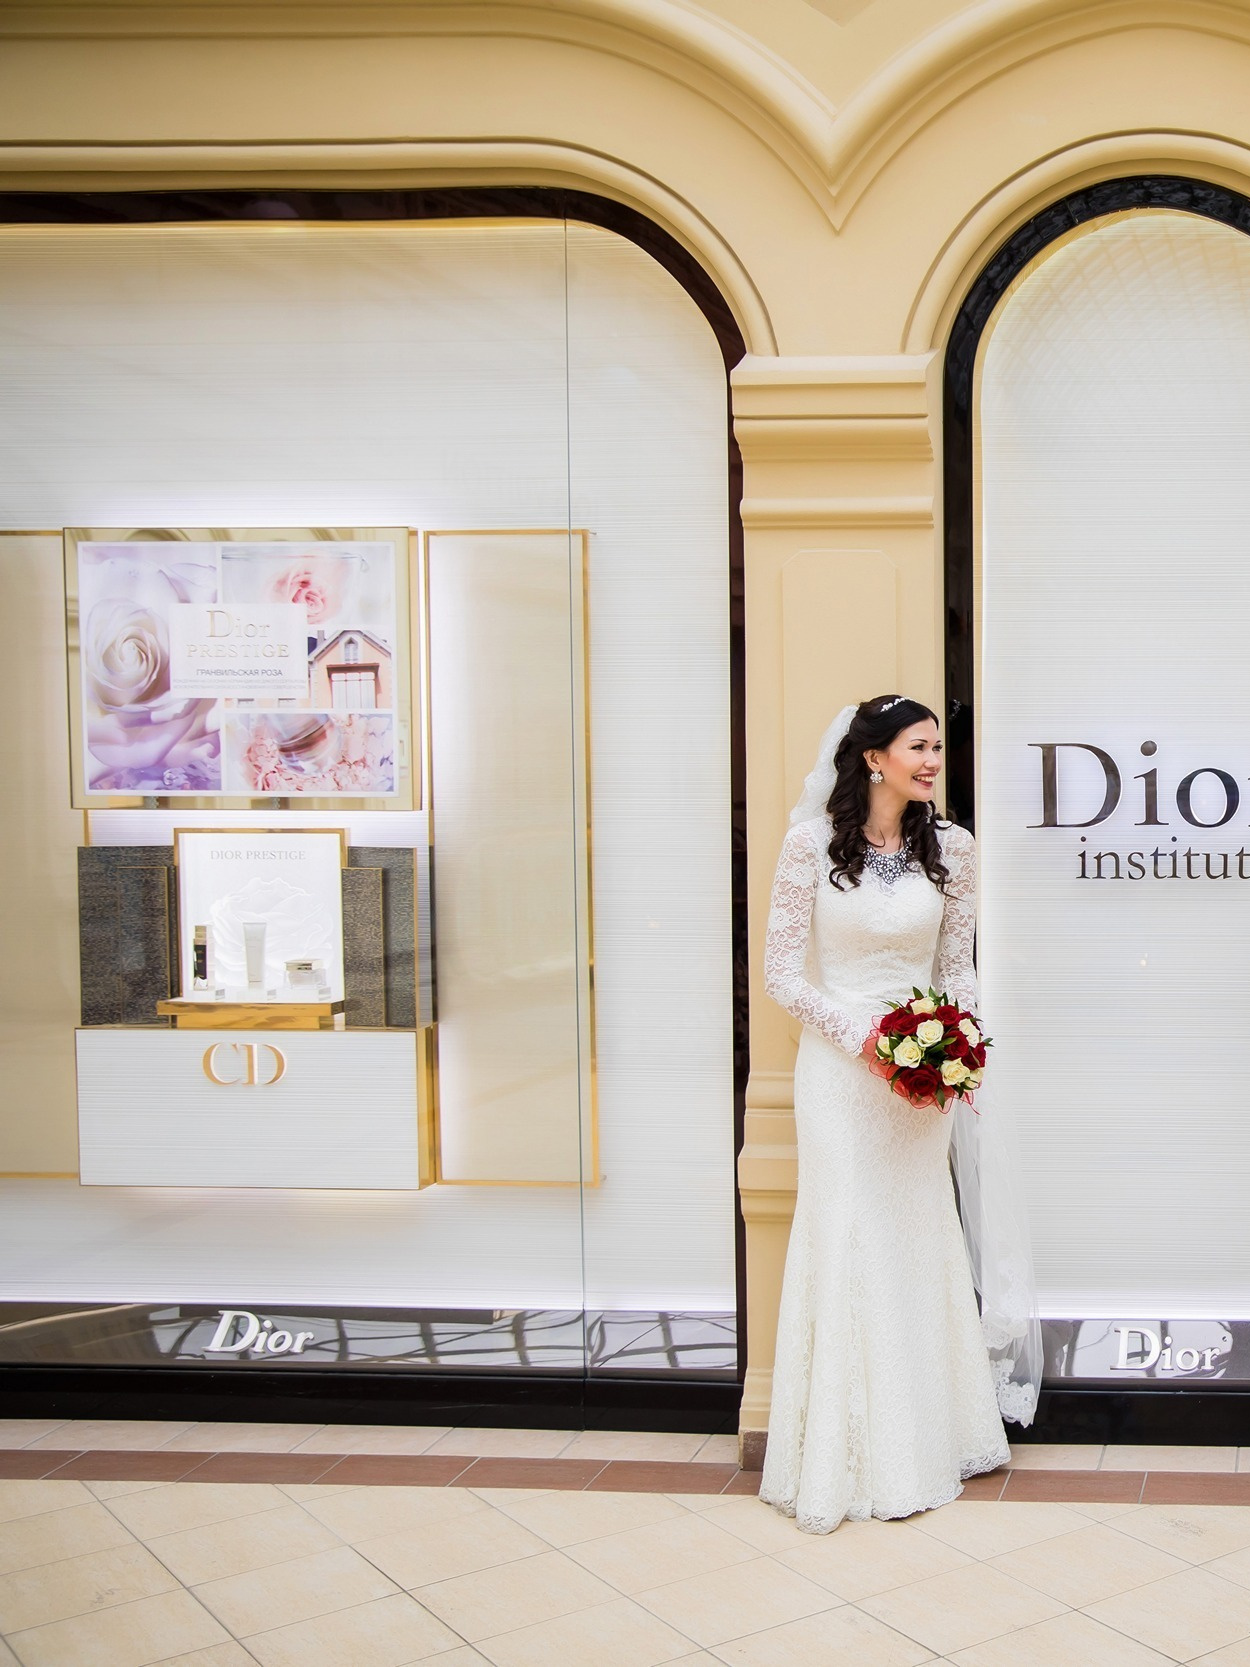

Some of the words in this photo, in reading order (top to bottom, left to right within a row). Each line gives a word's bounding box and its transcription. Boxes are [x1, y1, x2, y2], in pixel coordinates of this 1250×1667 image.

[206, 610, 270, 638] Dior
[186, 644, 289, 658] PRESTIGE
[196, 669, 259, 677] ГРАНВИЛЬСКАЯ
[261, 669, 283, 677] РОЗА
[210, 850, 242, 860] DIOR
[246, 850, 307, 860] PRESTIGE
[203, 1042, 287, 1086] CD
[202, 1310, 314, 1353] Dior
[1110, 1327, 1221, 1372] Dior
